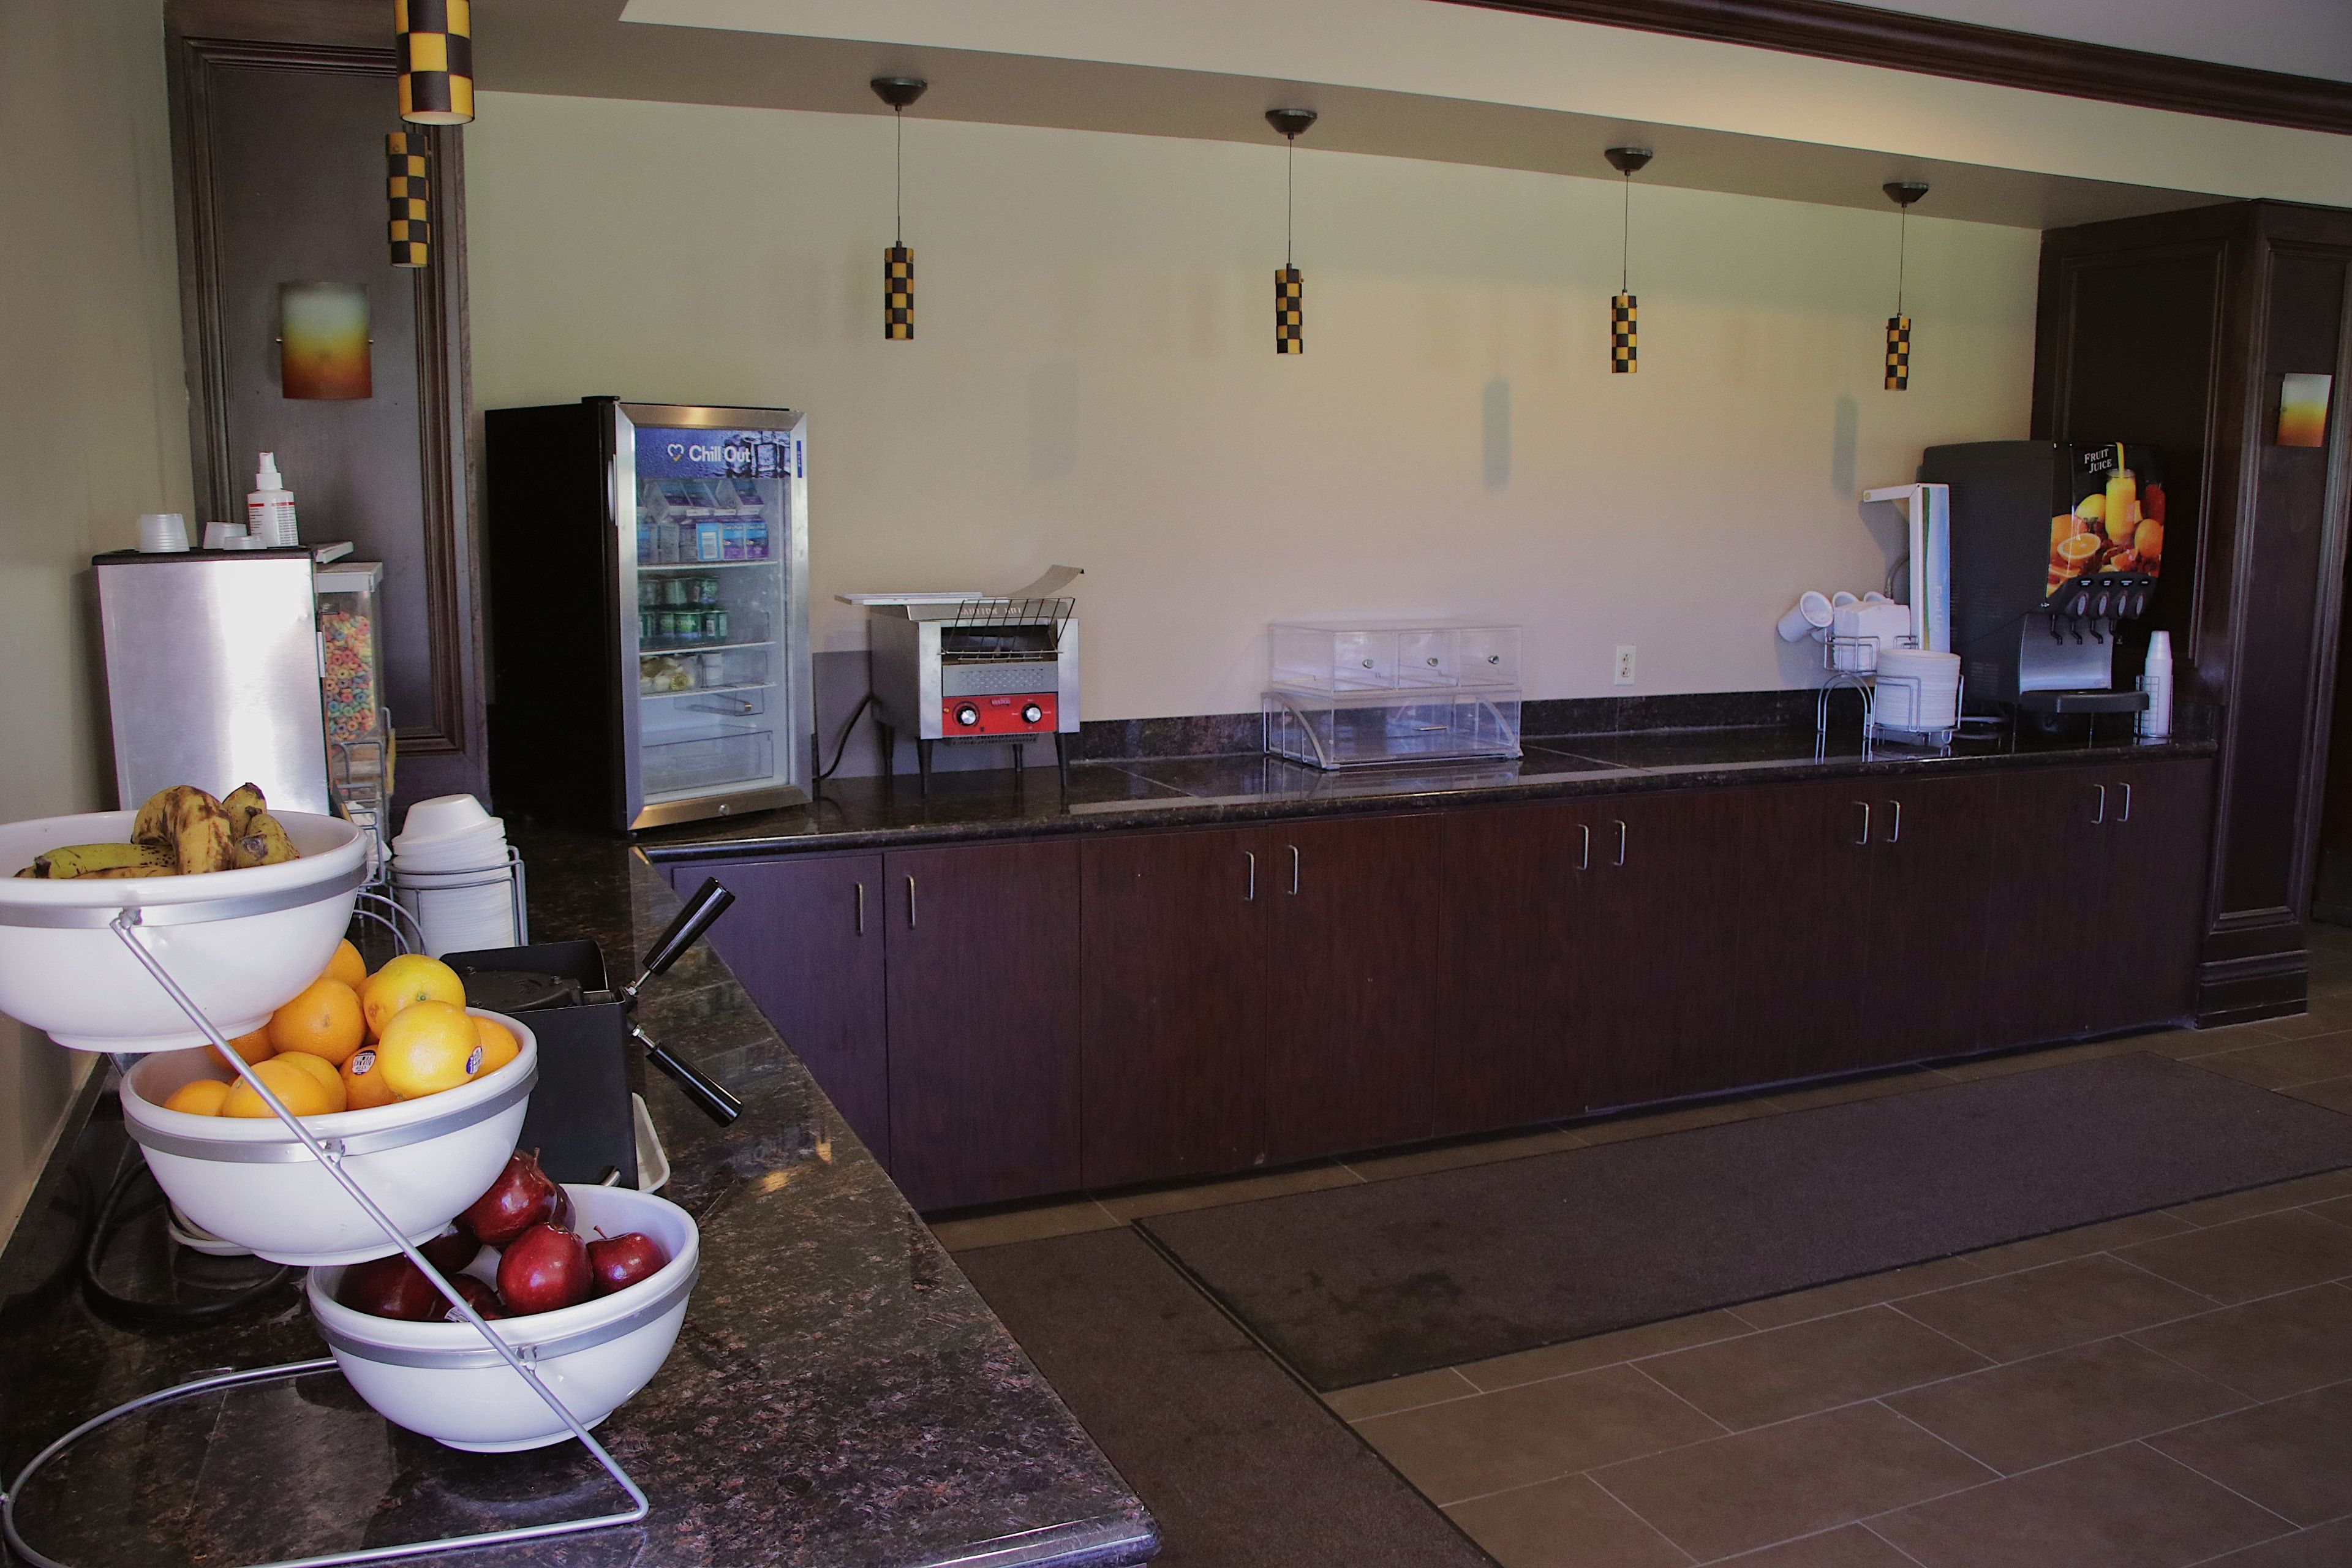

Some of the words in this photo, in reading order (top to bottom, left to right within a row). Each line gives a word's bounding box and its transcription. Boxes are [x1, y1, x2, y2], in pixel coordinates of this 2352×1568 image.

[688, 445, 722, 462] Chill
[724, 445, 751, 462] Out
[2084, 448, 2109, 464] FRUIT
[2089, 458, 2112, 473] JUICE
